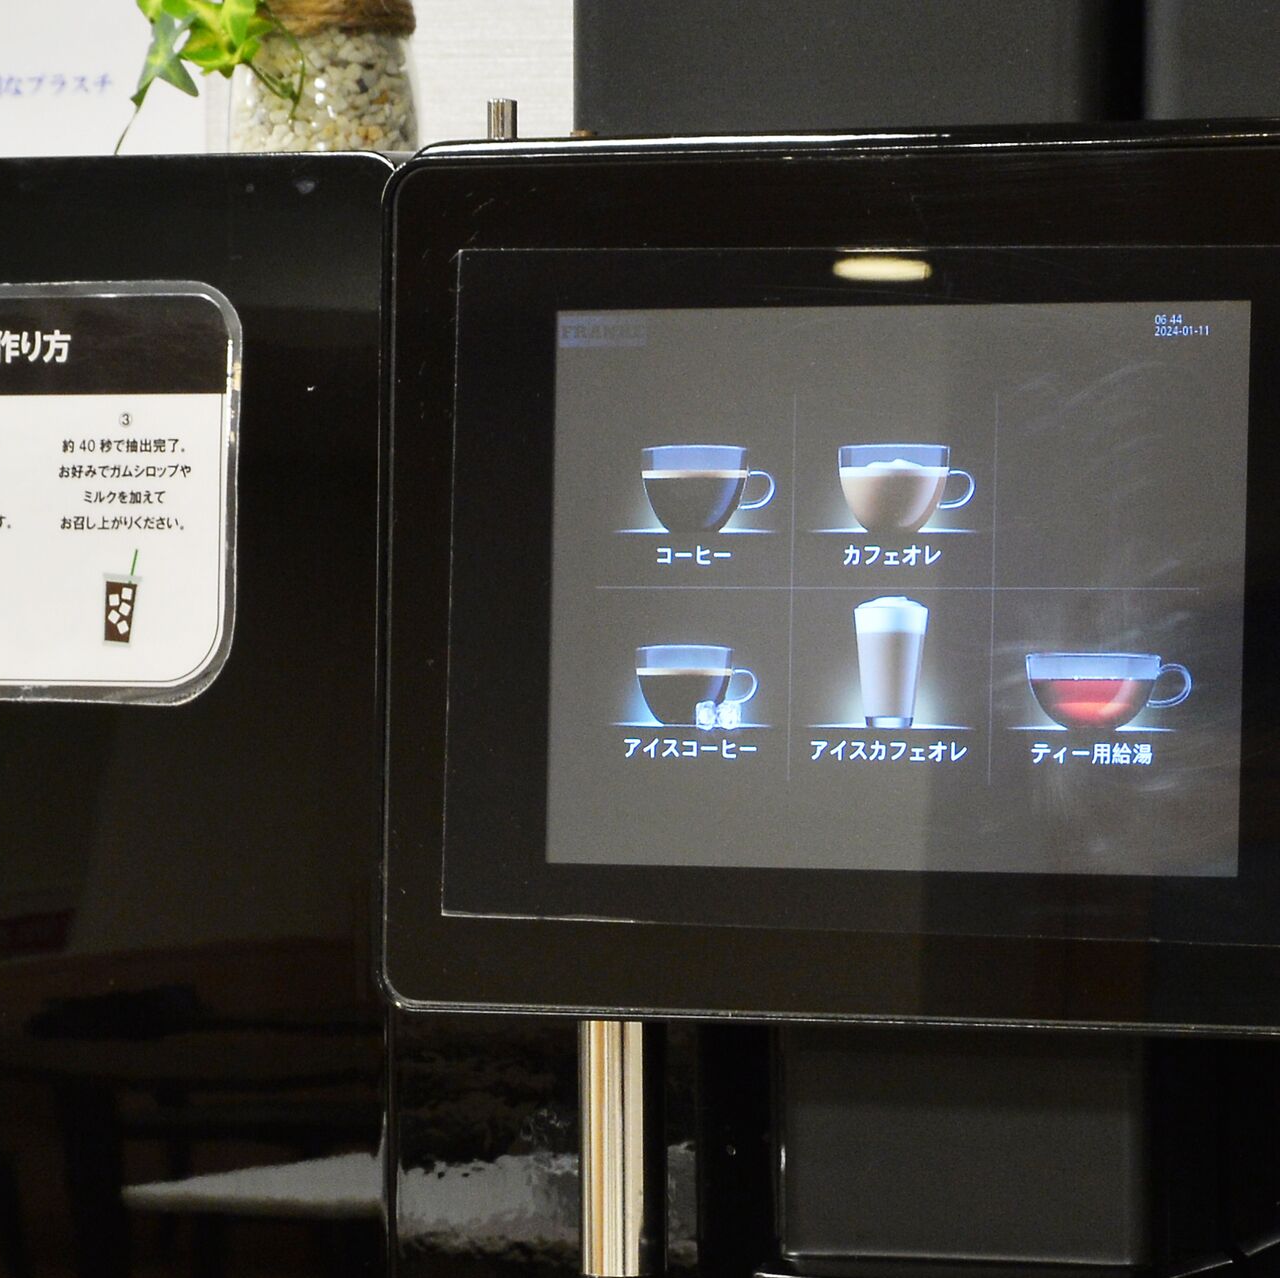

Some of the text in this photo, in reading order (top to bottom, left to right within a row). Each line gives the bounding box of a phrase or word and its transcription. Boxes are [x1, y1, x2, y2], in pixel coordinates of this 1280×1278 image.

[1155, 325, 1209, 337] 2024-01-11
[58, 463, 192, 480] お好みでガムシロップや
[83, 489, 166, 505] ミルクを加えて
[60, 515, 185, 531] お召し上がりください。
[656, 545, 732, 566] コーヒー
[843, 544, 942, 567] カフェオレ
[623, 737, 758, 759] アイスコーヒー
[810, 739, 968, 763] アイスカフェオレ
[1030, 742, 1153, 765] ティー用給湯
